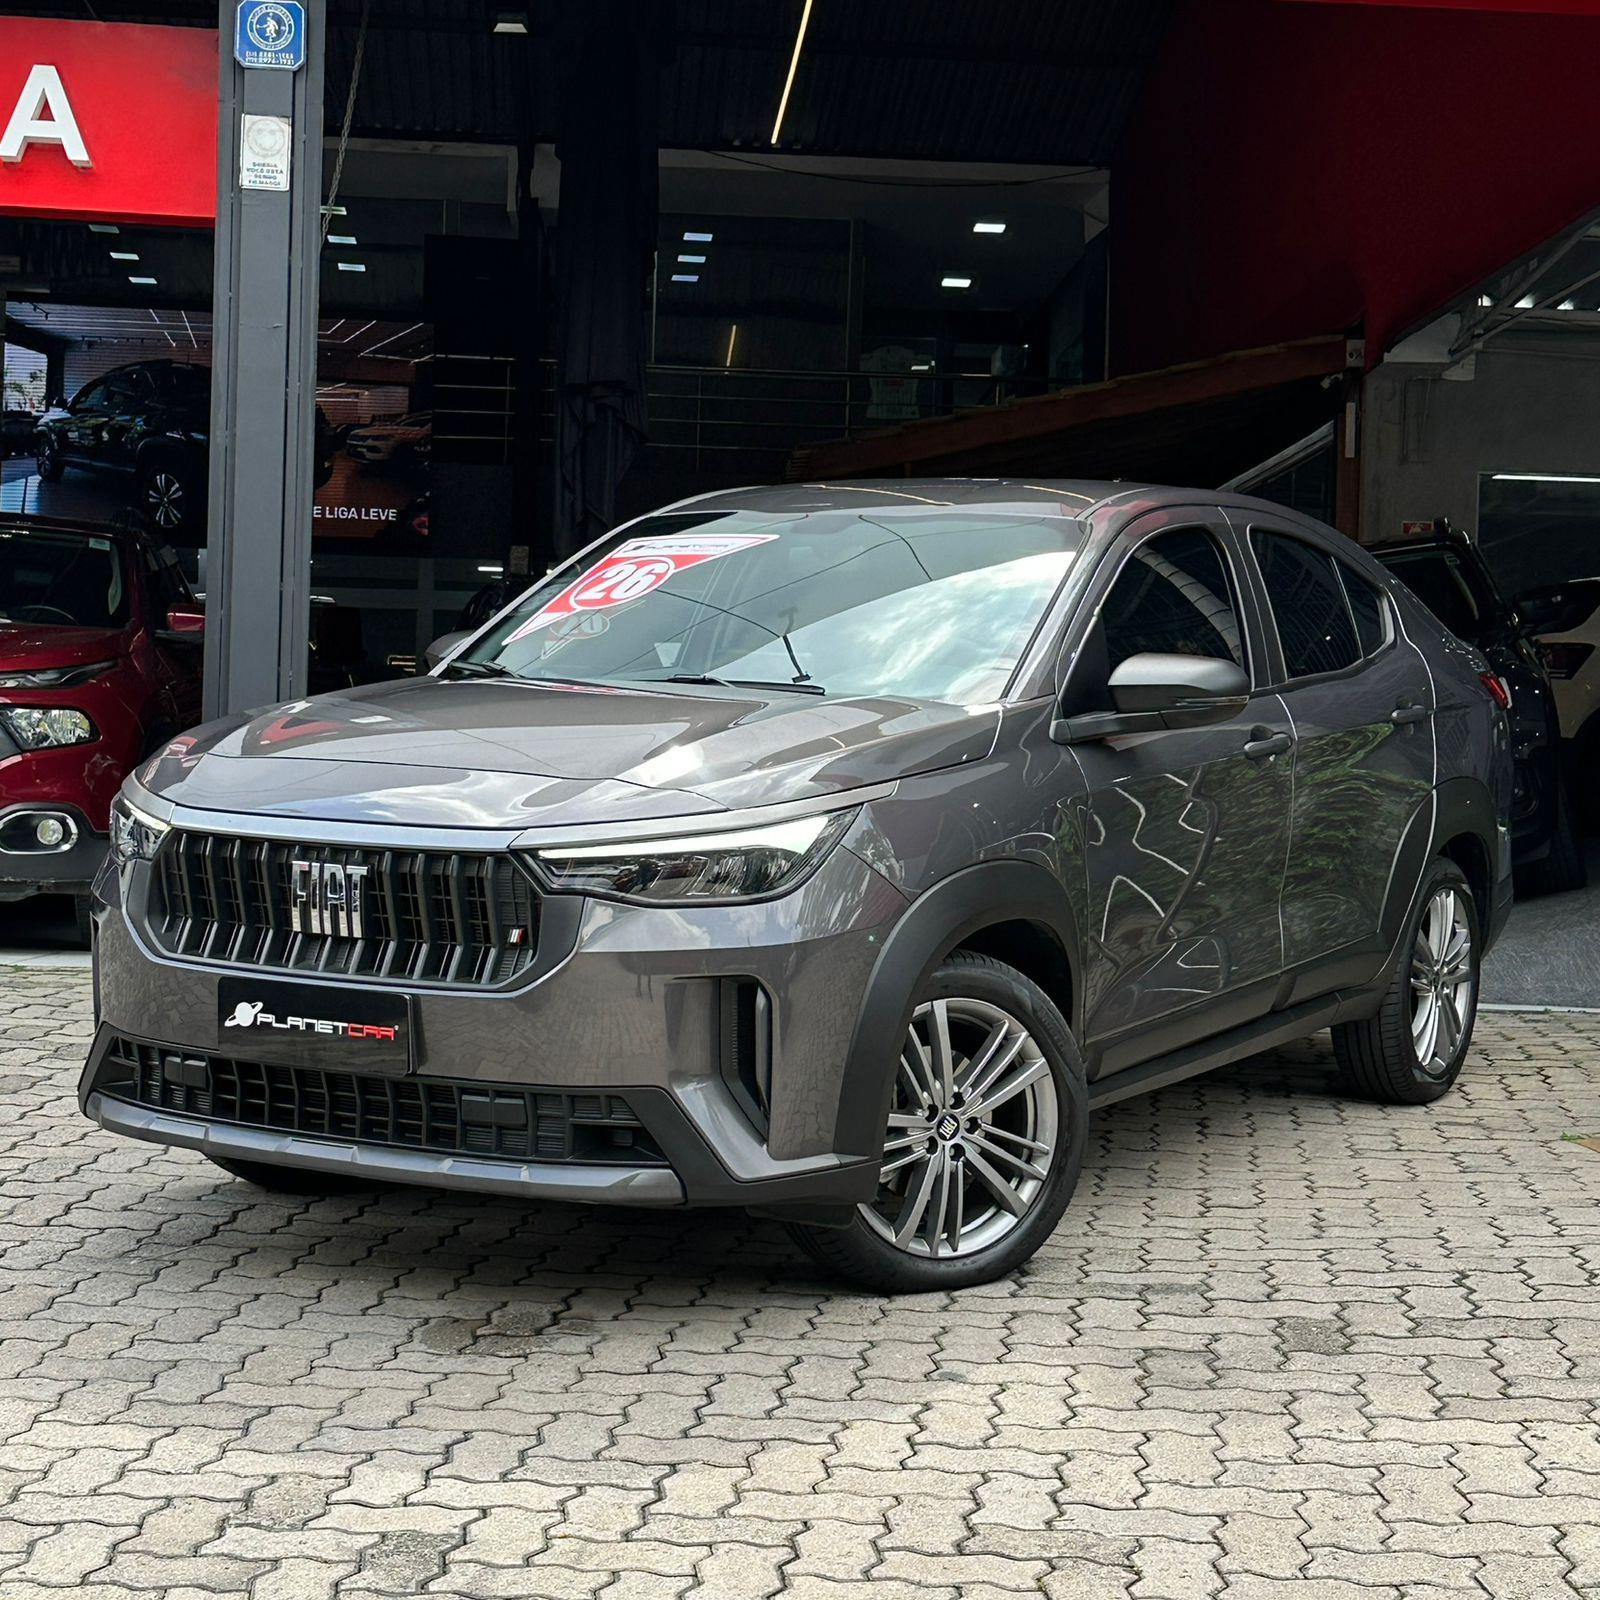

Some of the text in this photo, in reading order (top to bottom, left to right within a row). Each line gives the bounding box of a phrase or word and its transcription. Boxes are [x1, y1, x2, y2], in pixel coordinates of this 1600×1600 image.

[0, 64, 93, 168] A
[325, 506, 358, 519] LIGA
[361, 507, 398, 521] LEVE
[574, 563, 669, 600] 26
[292, 861, 368, 938] FIAT
[256, 1012, 395, 1041] PLANETCAR
